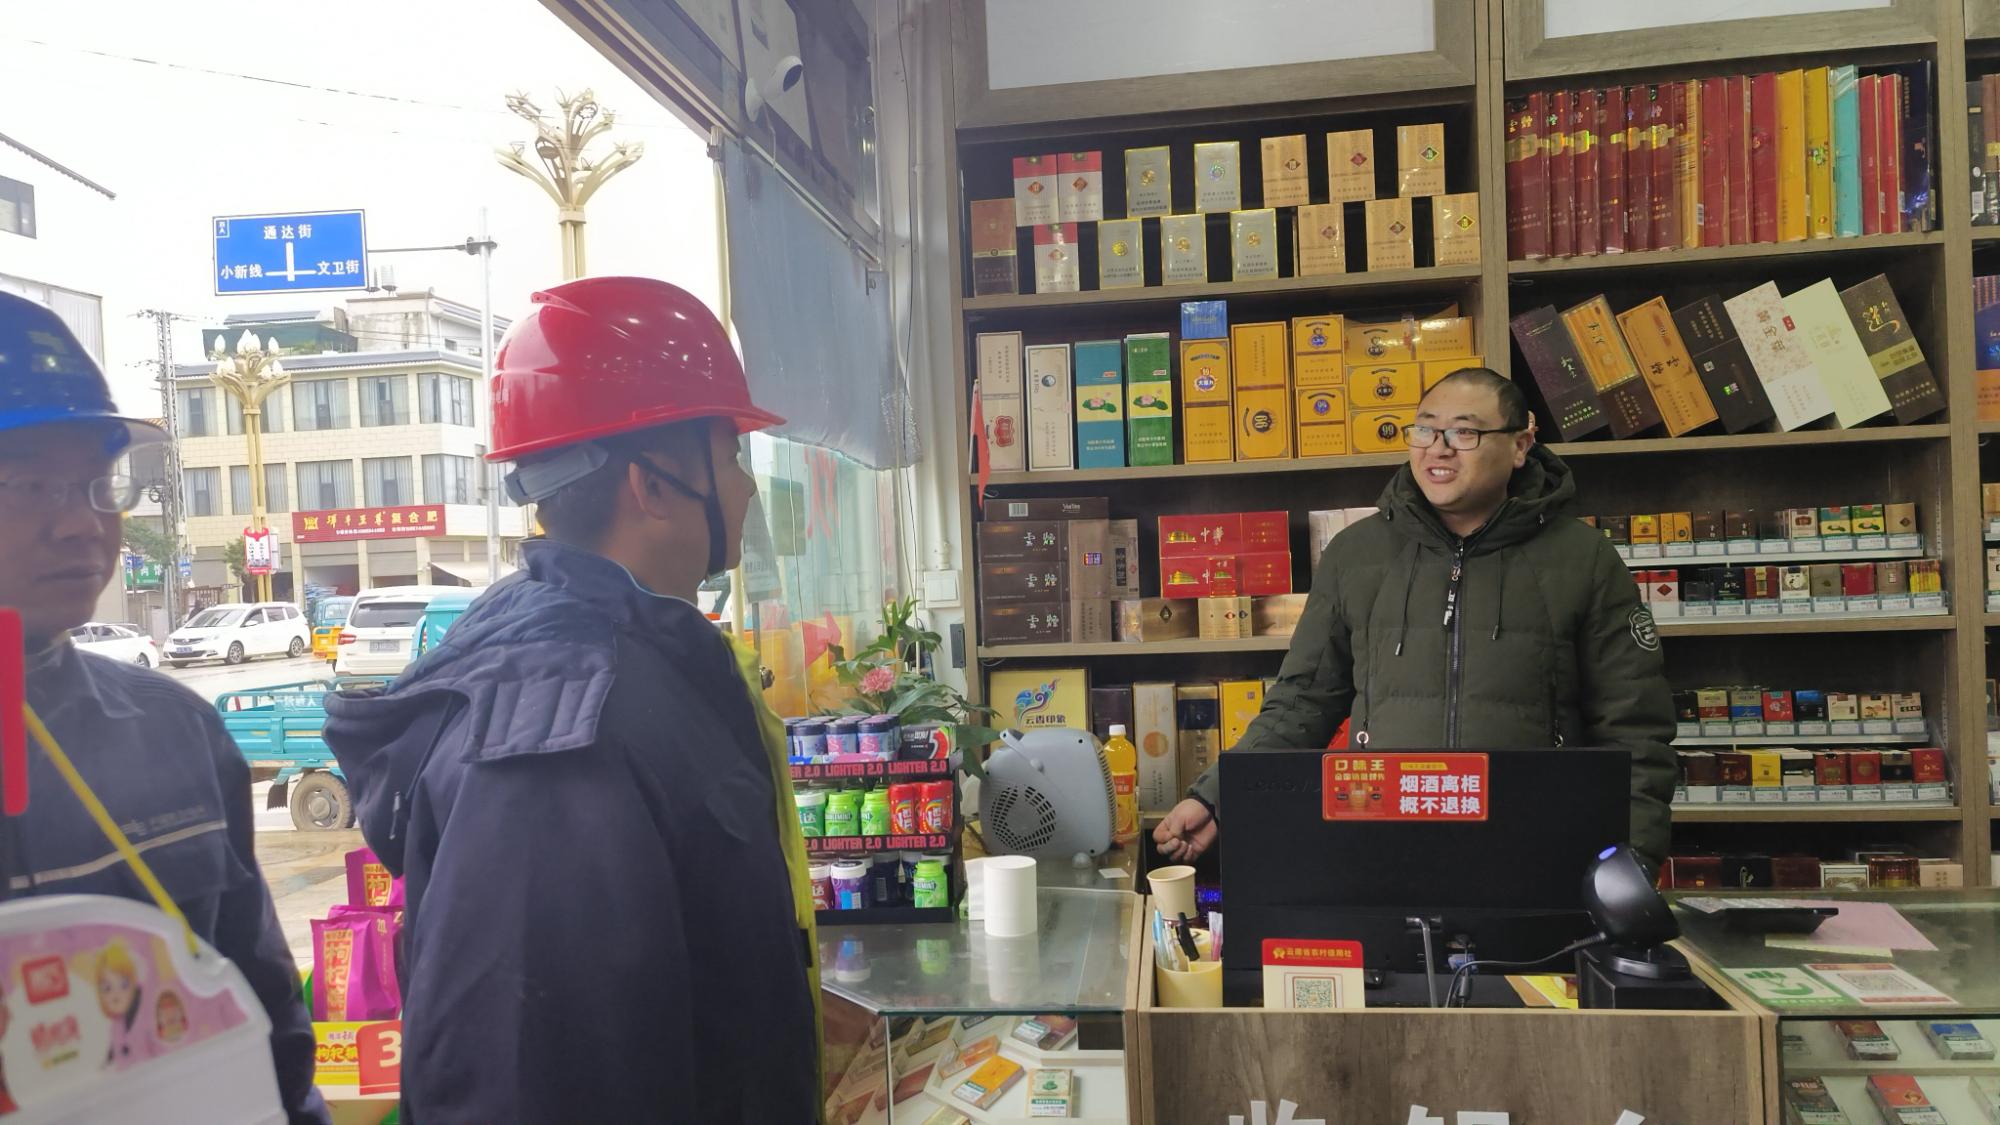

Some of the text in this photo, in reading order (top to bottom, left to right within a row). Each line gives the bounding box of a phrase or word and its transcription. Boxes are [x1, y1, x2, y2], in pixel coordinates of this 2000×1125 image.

[263, 224, 313, 240] 通达街
[220, 264, 263, 280] 小新线
[316, 259, 360, 276] 文卫街
[825, 765, 865, 777] LIGHTER
[868, 763, 883, 776] 2.0
[888, 761, 928, 775] LIGHTER
[931, 760, 947, 774] 2.0
[1334, 759, 1385, 771] 口味王
[1400, 774, 1481, 793] 烟酒离柜
[1400, 796, 1481, 815] 概不退换
[823, 837, 863, 849] LIGHTER
[866, 836, 882, 848] 2.0
[886, 834, 927, 847] LIGHTER
[930, 833, 946, 846] 2.0
[378, 1030, 401, 1068] 3
